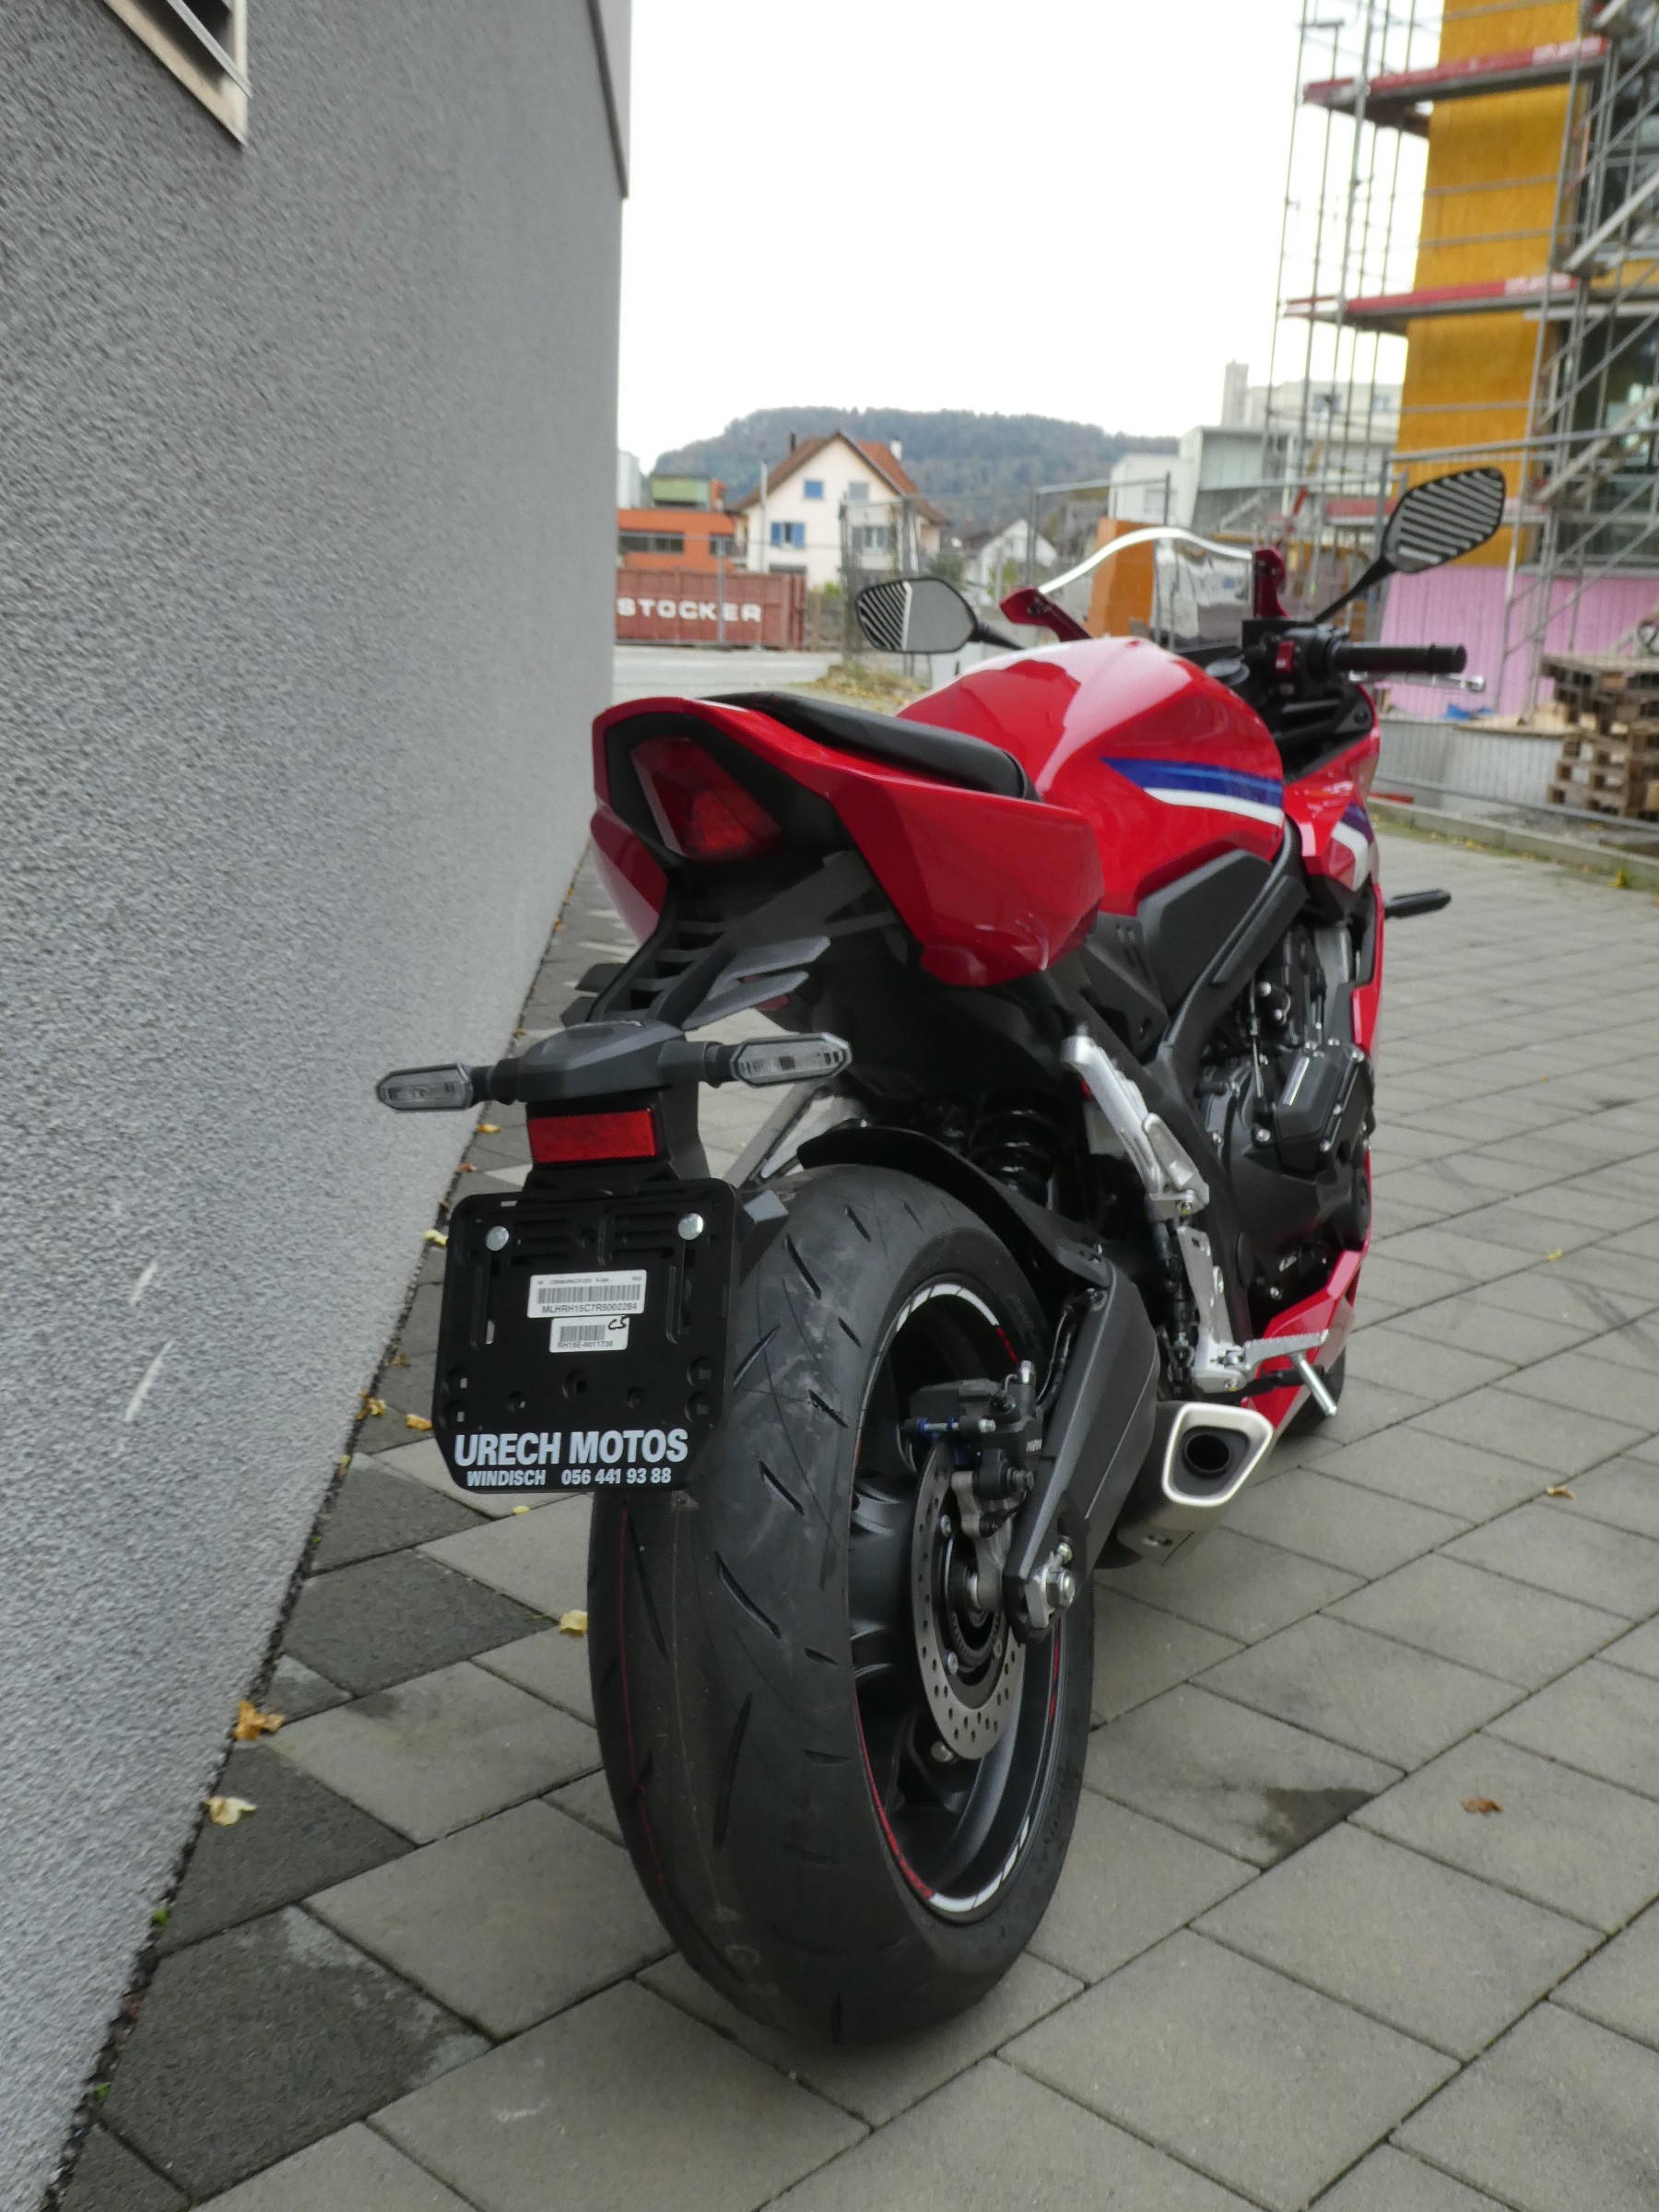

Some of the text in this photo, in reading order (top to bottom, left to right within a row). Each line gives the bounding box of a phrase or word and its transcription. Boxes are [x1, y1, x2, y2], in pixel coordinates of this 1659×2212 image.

[617, 597, 761, 622] STOCKER
[454, 1429, 688, 1466] URECH MOTOS
[466, 1467, 672, 1487] WINDISCH 056 441 93 88
